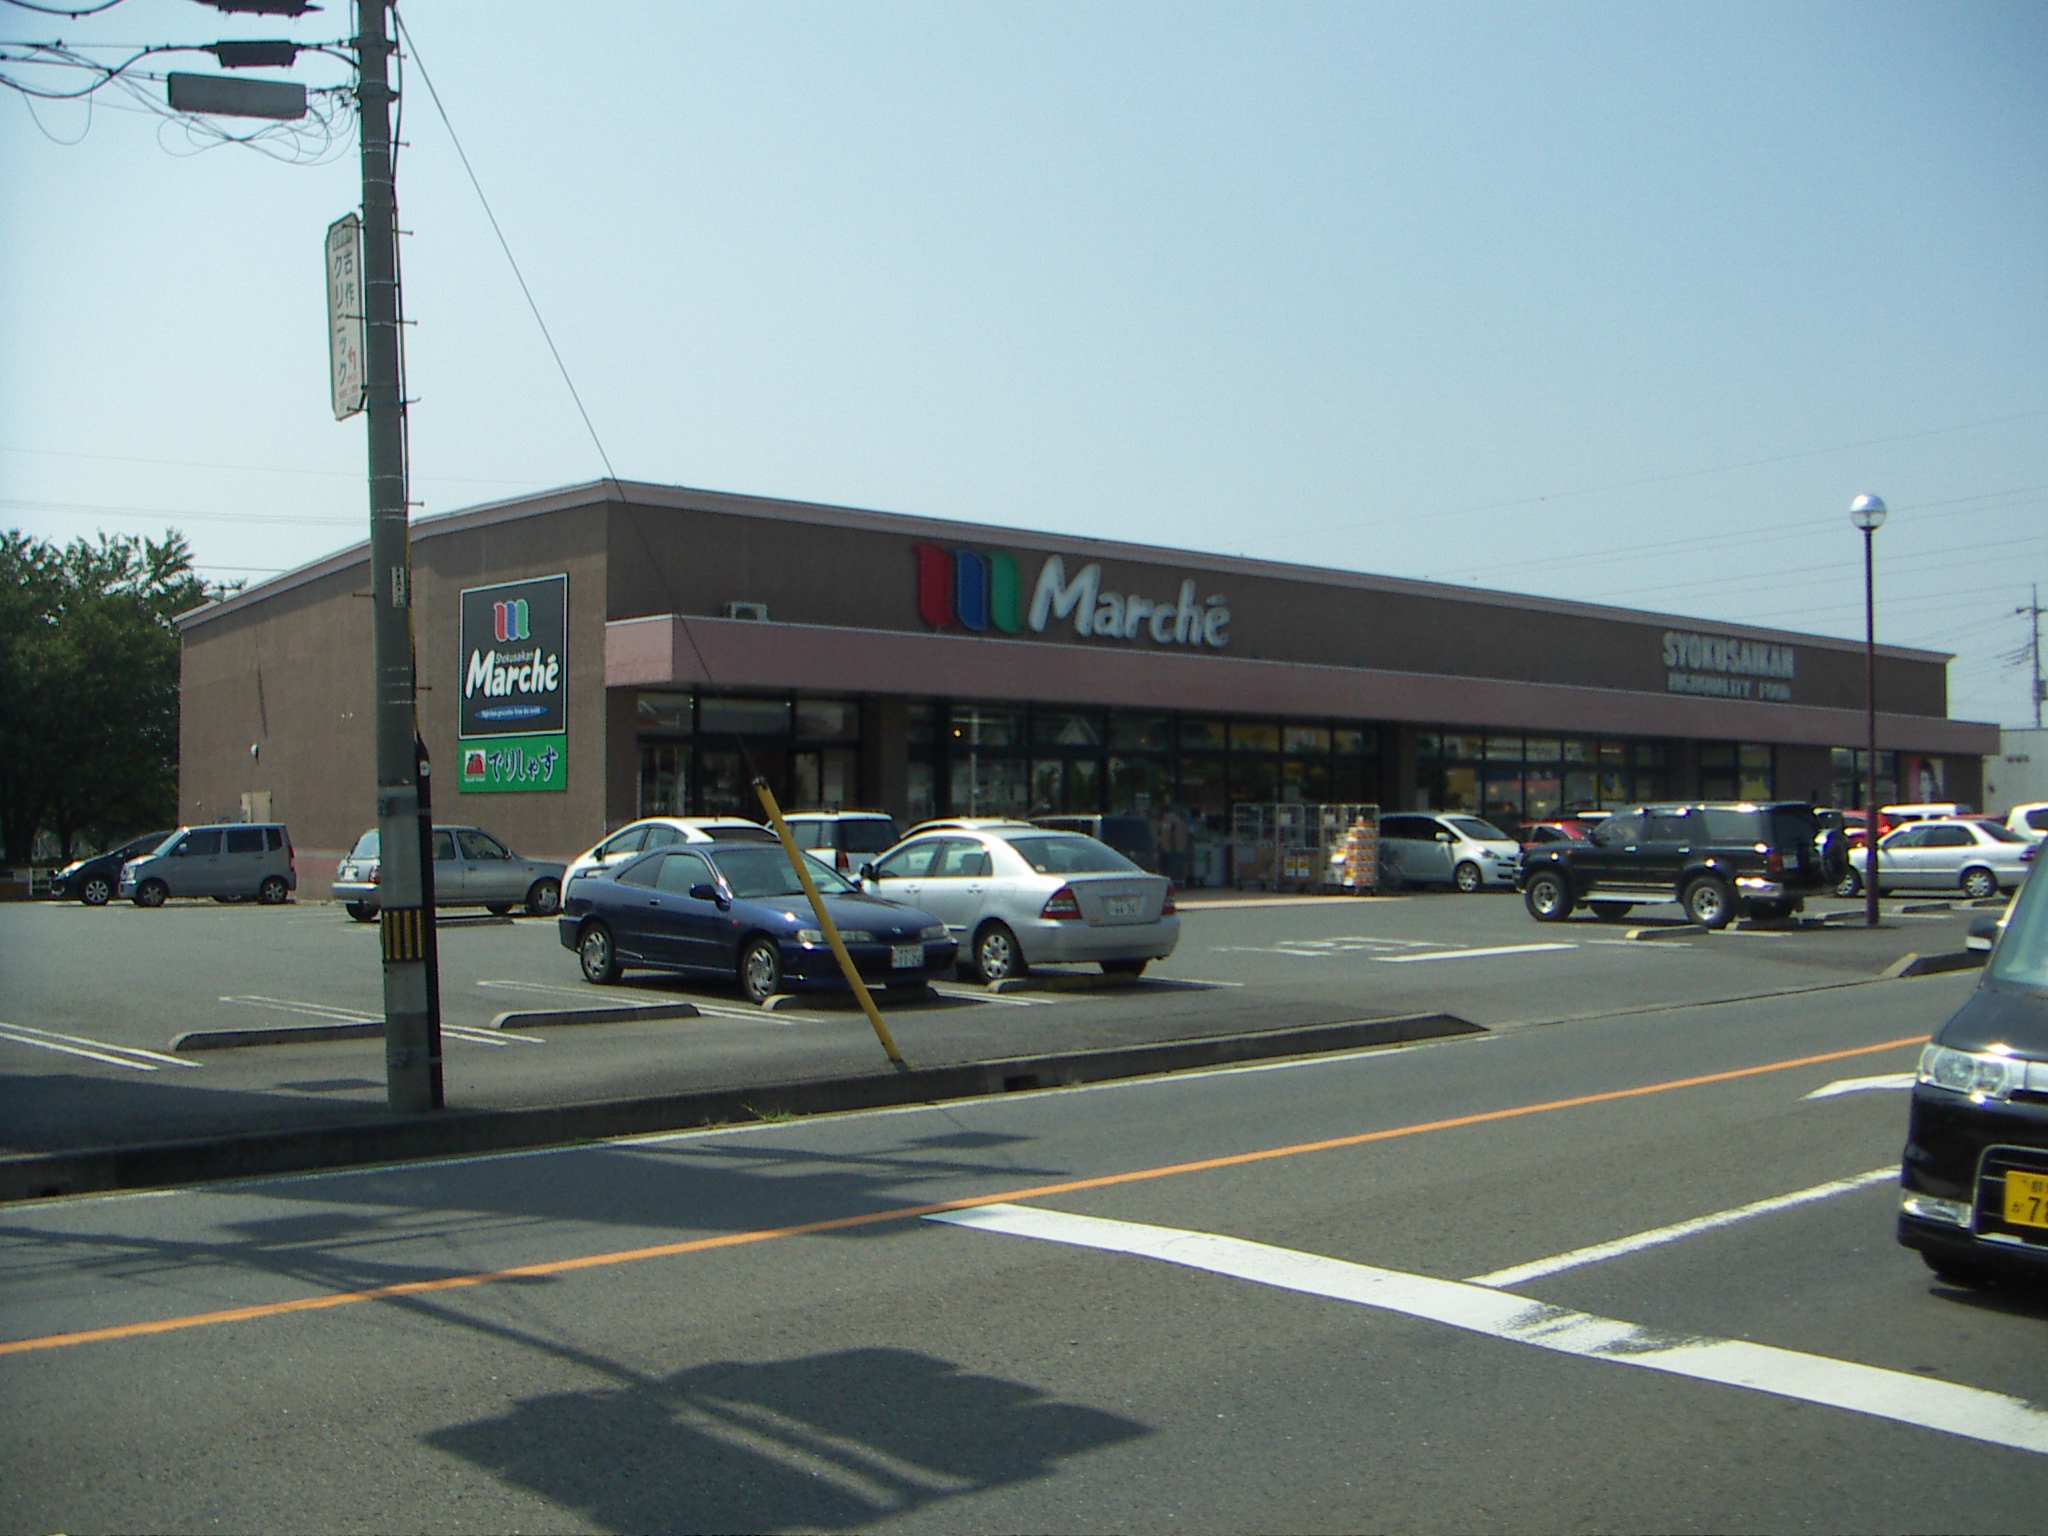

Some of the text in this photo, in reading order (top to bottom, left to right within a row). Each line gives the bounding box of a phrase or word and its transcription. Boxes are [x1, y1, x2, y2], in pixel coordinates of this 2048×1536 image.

[334, 253, 347, 387] クリニック
[1028, 554, 1231, 648] Marché
[465, 647, 559, 699] Marché
[488, 744, 559, 782] でりしゃす
[2028, 1196, 2048, 1223] 7
